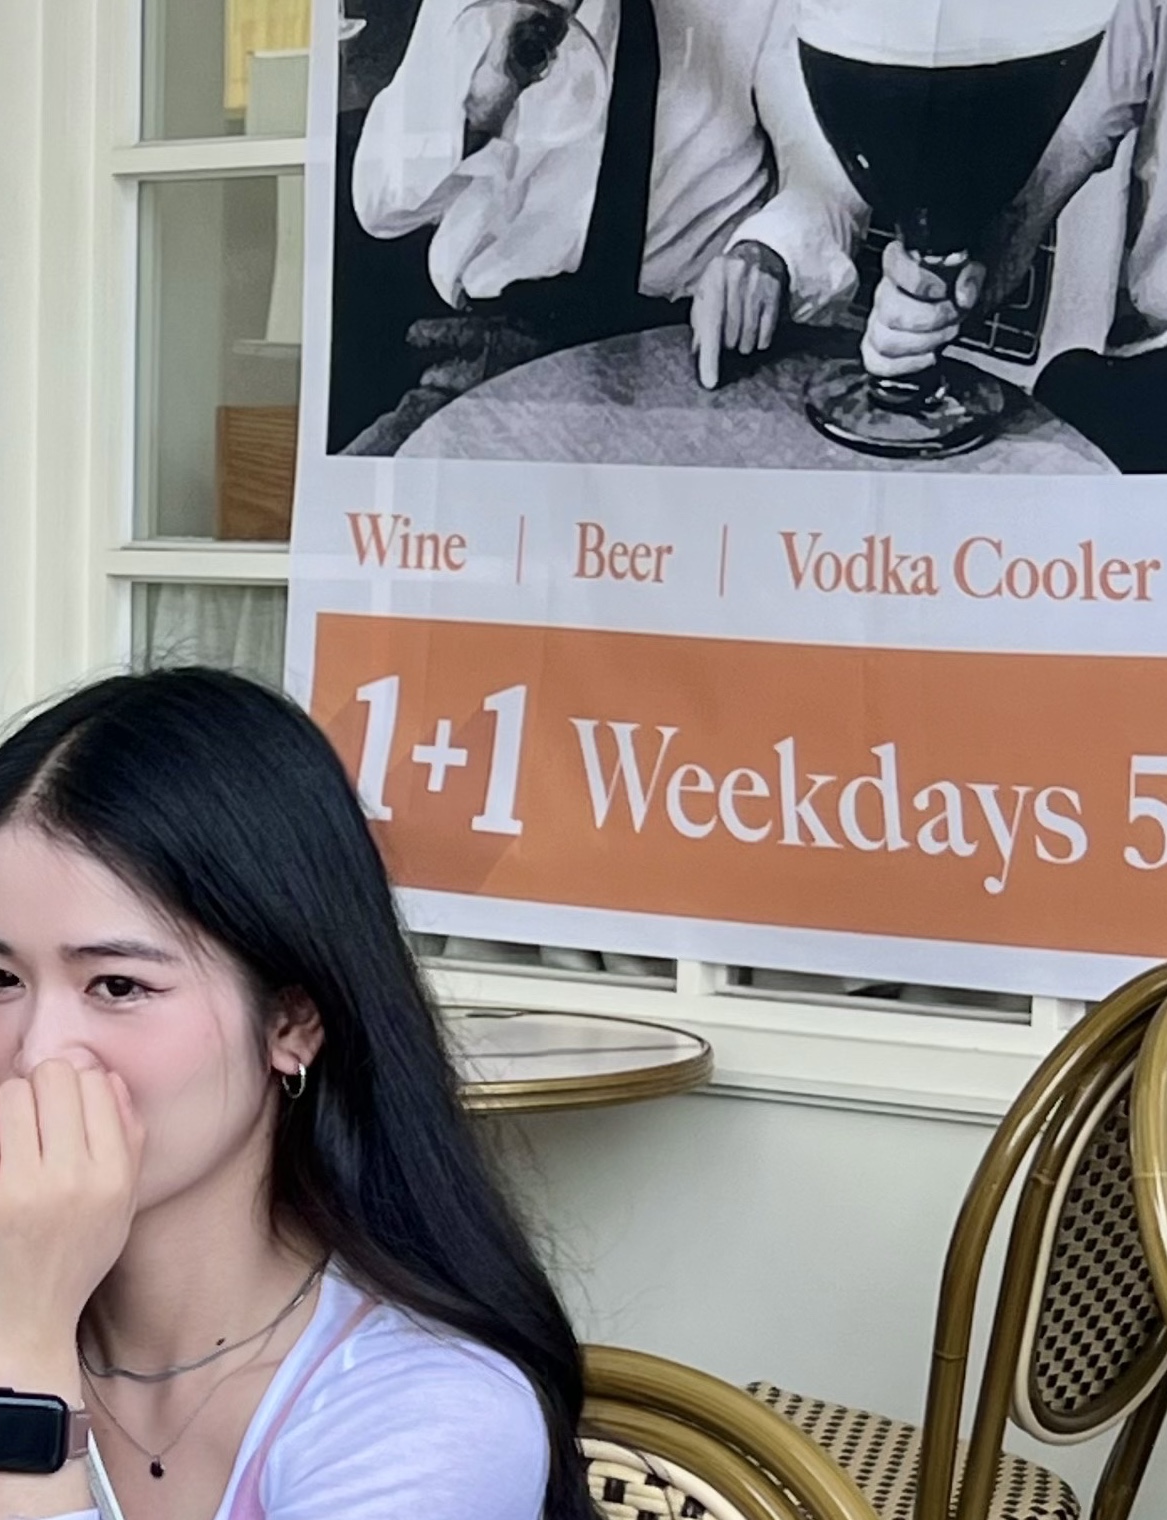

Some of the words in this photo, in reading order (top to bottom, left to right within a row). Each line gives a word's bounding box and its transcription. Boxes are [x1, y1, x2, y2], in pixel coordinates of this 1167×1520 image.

[346, 512, 467, 571] Wine
[574, 522, 674, 584] Beer
[779, 531, 938, 598] Vodka
[953, 536, 1161, 602] Cooler
[356, 675, 527, 836] 1+1
[569, 716, 1089, 894] Weekdays
